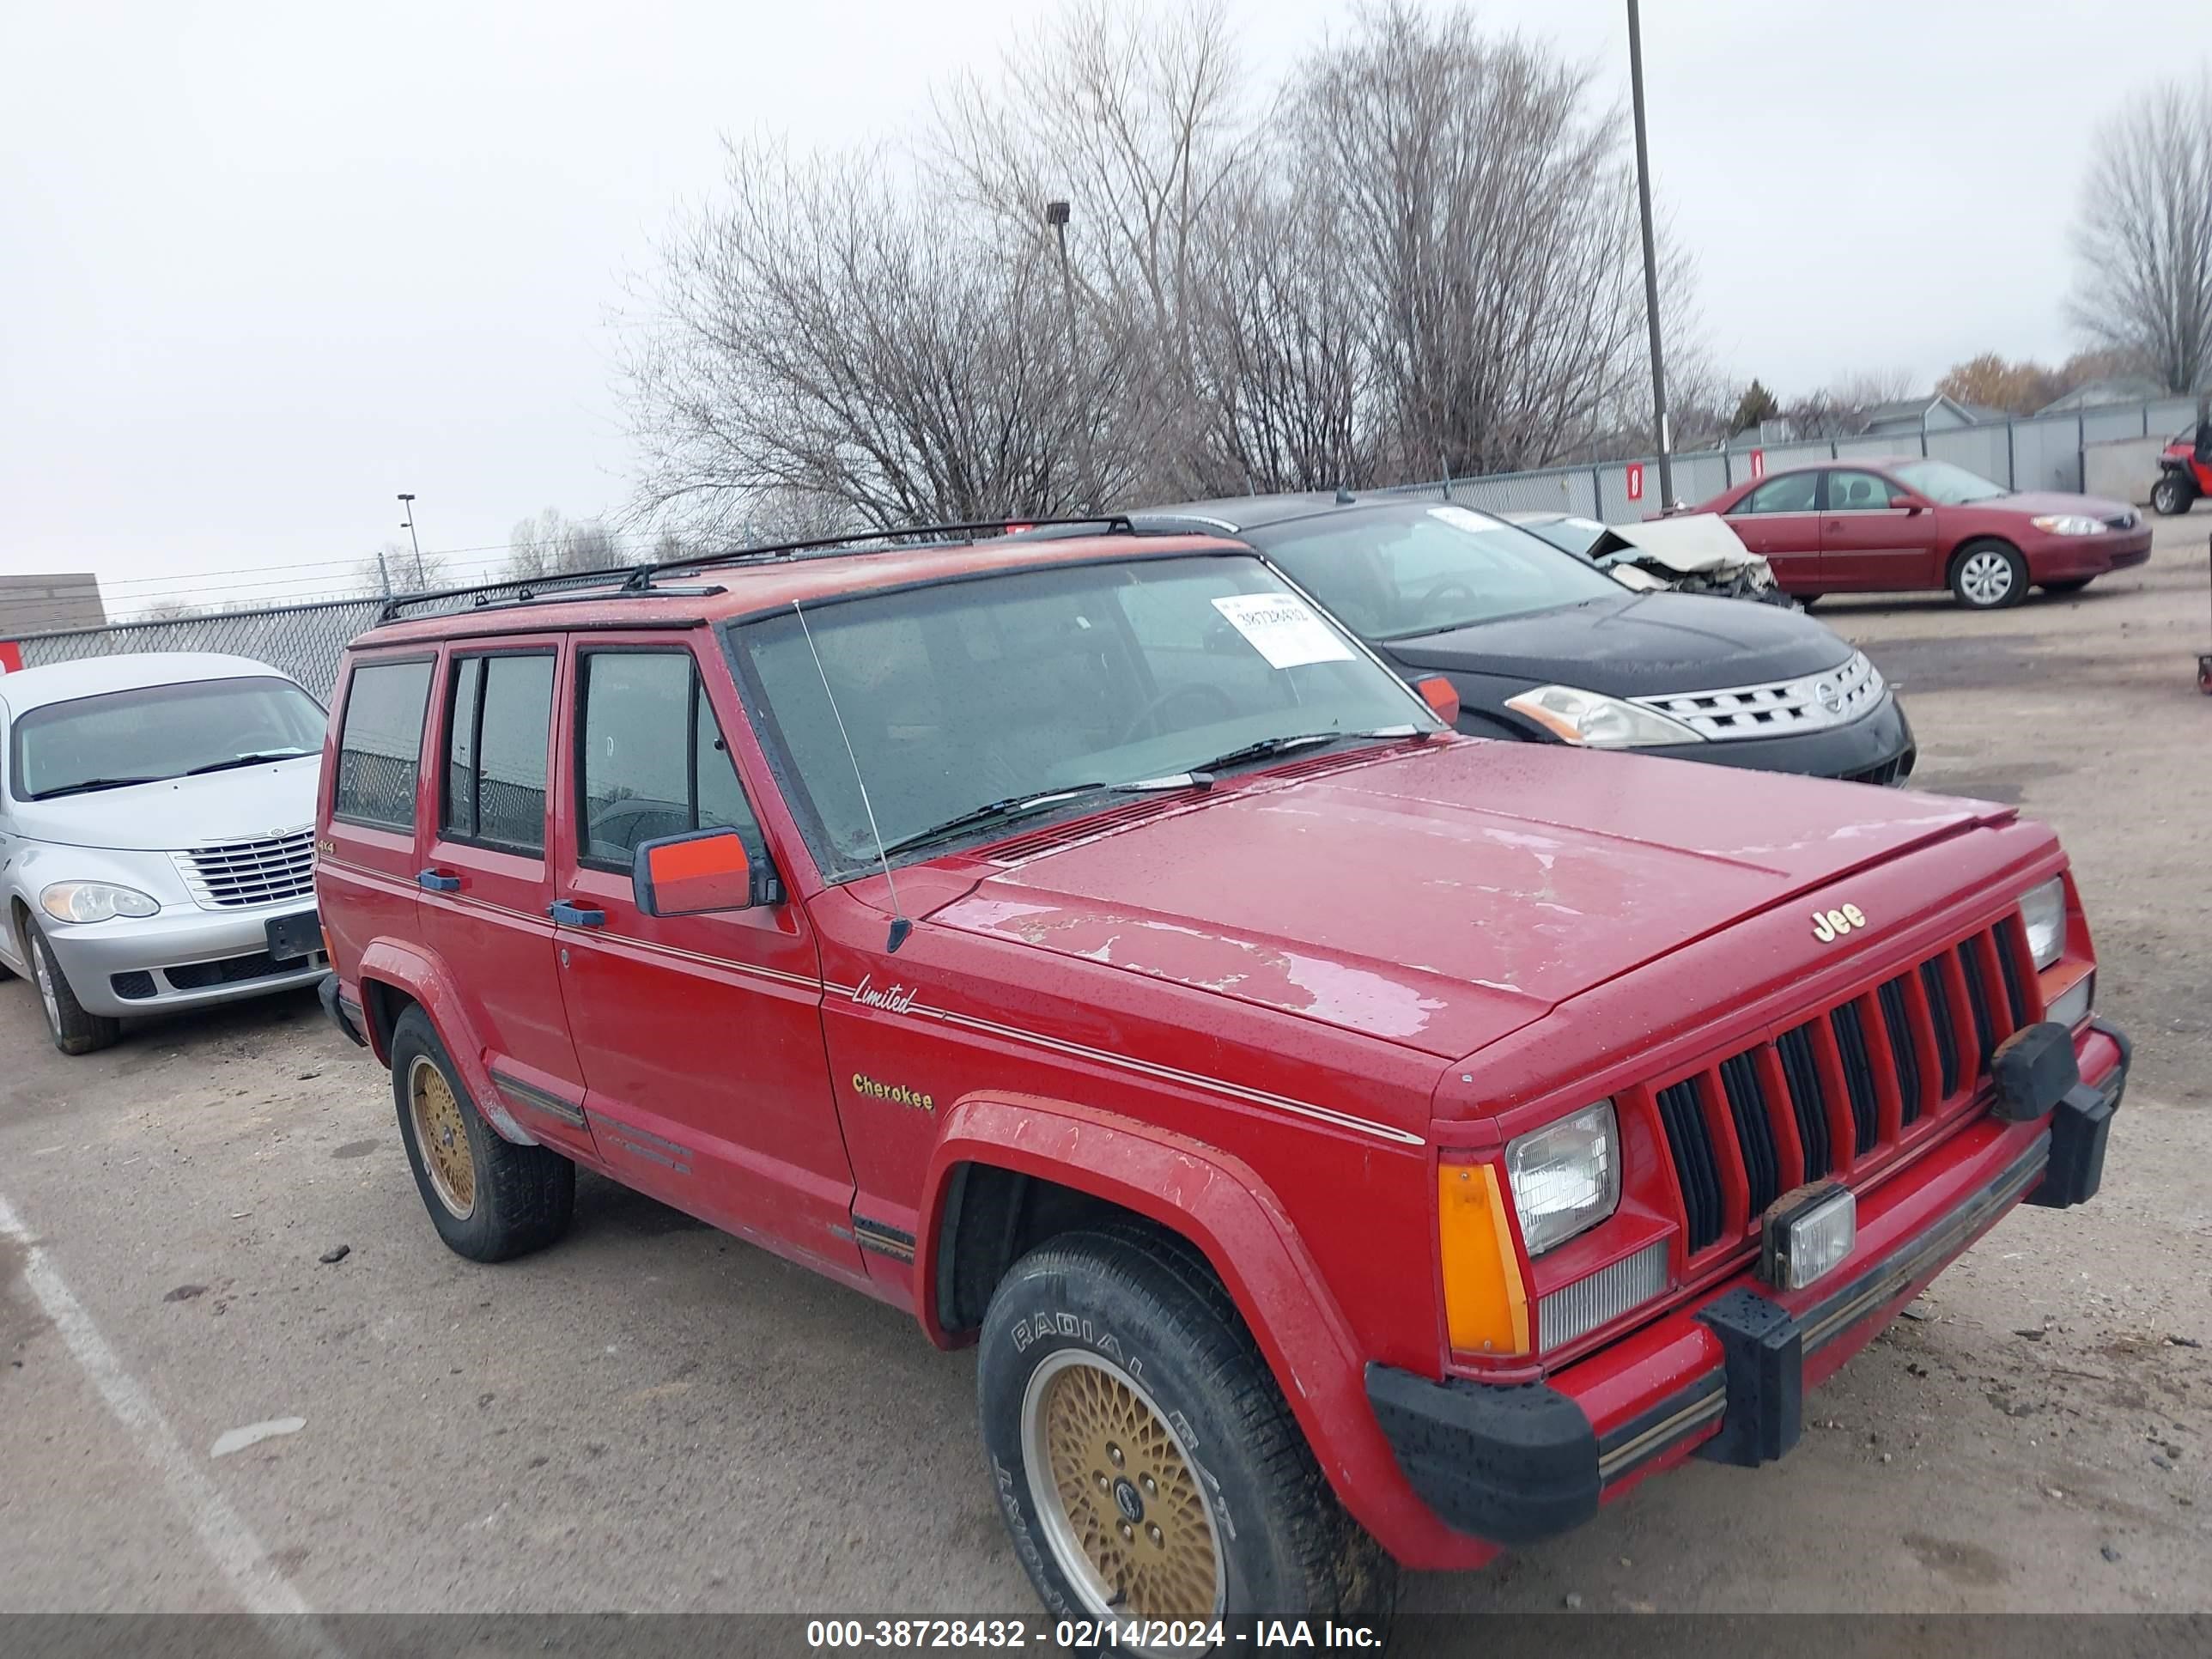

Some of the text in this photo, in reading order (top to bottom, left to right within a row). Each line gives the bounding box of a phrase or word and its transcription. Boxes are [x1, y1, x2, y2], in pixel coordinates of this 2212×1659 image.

[1812, 902, 1866, 943] Jee
[852, 973, 918, 1015] Limited
[852, 1073, 934, 1110] Cherokee
[1011, 1311, 1154, 1396] RADIAL
